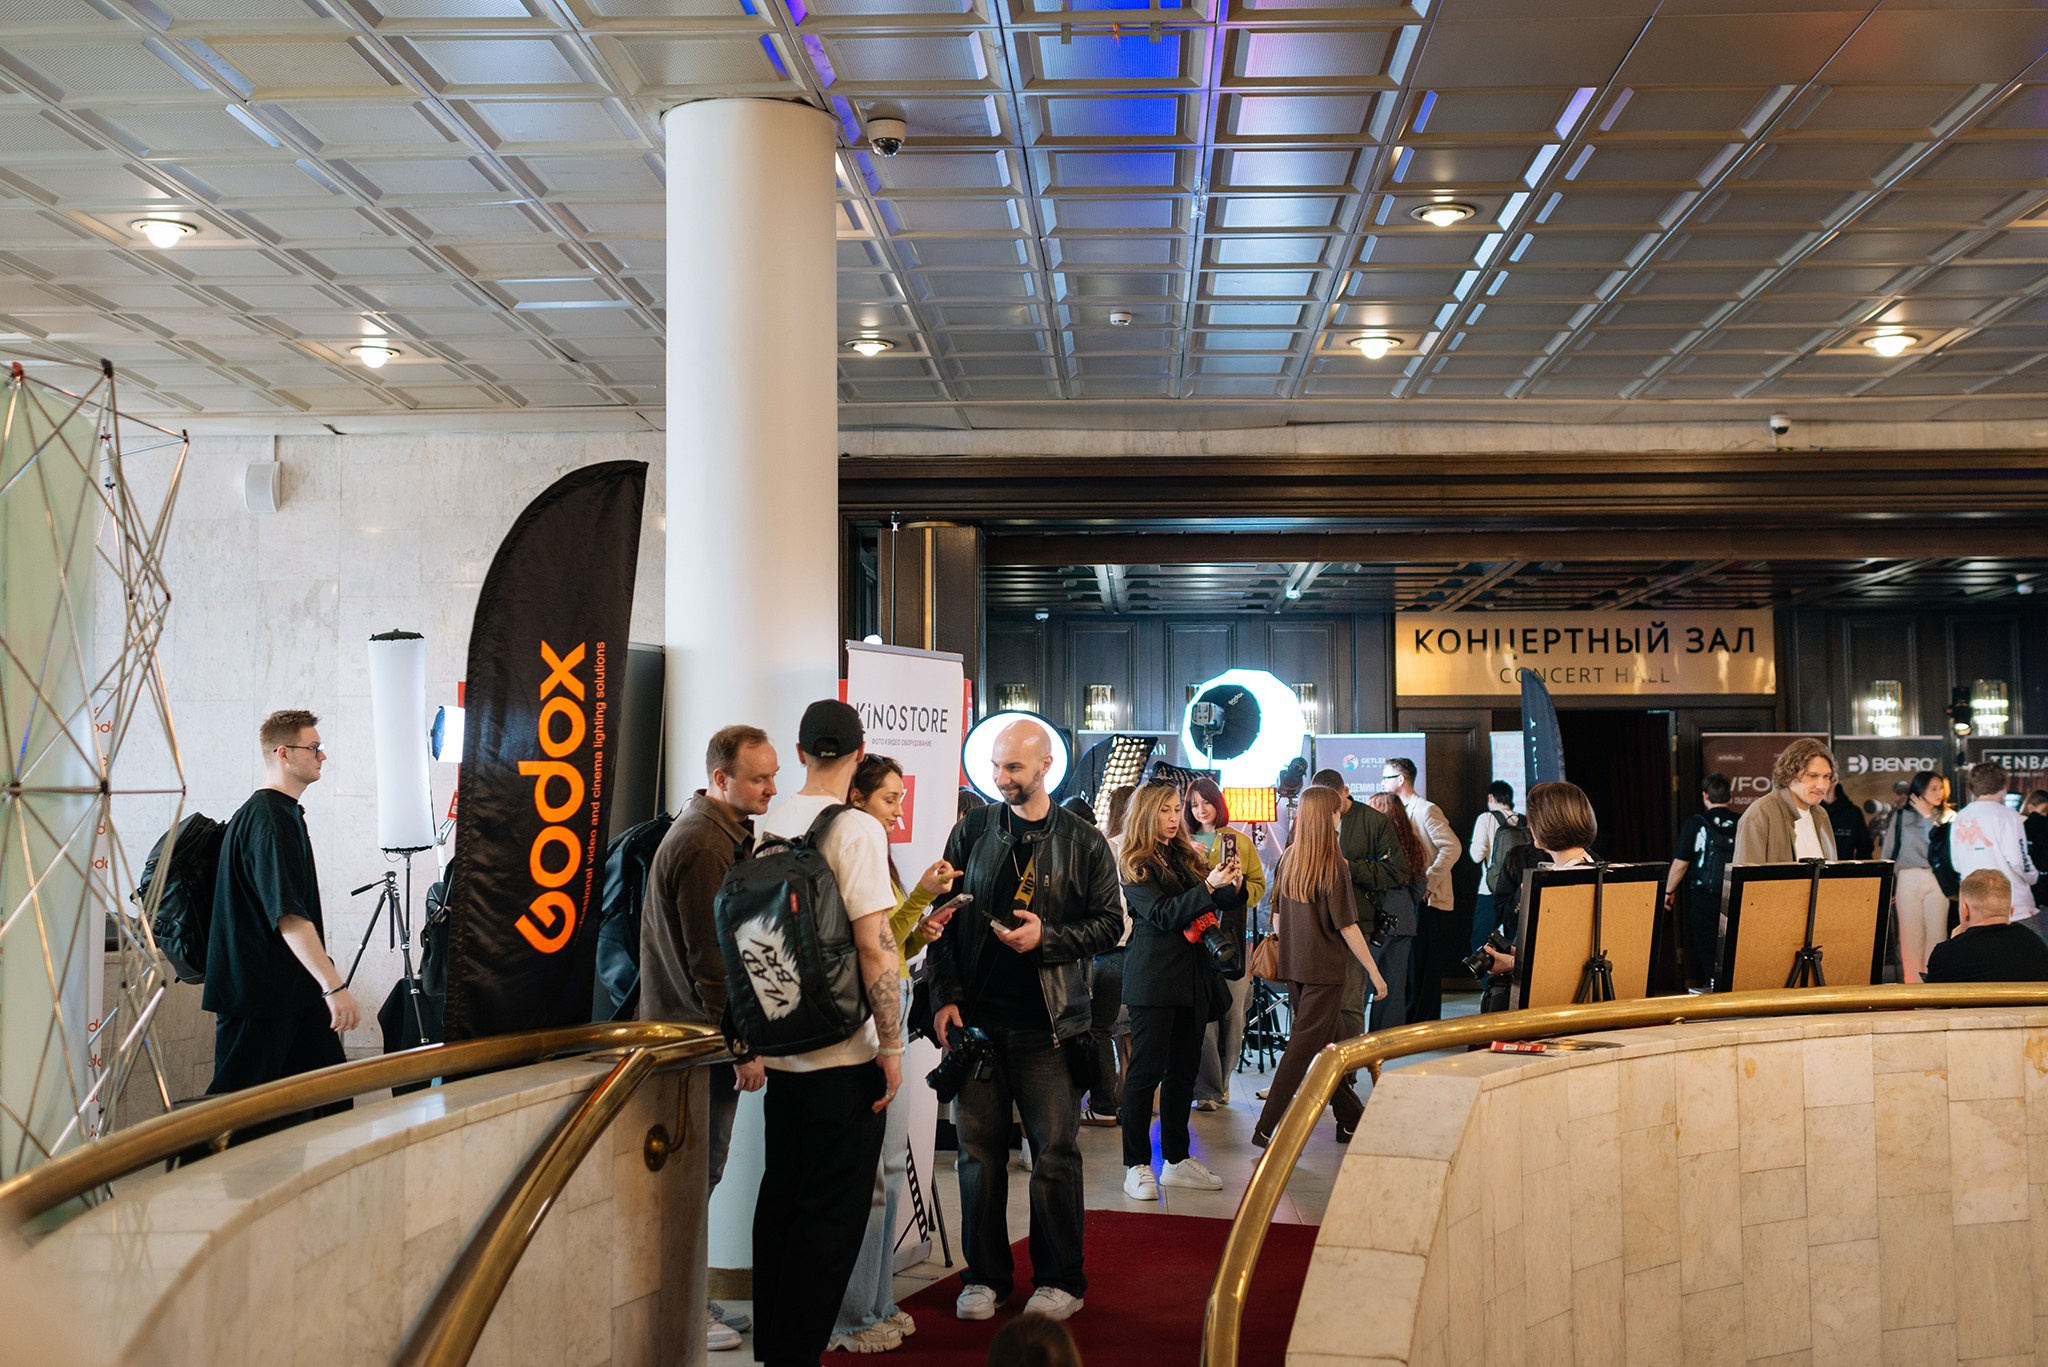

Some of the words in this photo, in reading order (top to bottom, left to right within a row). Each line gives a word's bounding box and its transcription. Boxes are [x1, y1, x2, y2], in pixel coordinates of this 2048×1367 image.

[1414, 621, 1670, 660] КОНЦЕРТНЫЙ
[1686, 627, 1755, 654] ЗАЛ
[594, 641, 606, 699] solutions
[1615, 667, 1671, 684] HALL
[592, 701, 607, 748] lighting
[591, 751, 604, 798] cinema
[1872, 757, 1935, 772] BENRO
[514, 640, 586, 954] Godox
[591, 801, 601, 826] and
[587, 829, 597, 864] video
